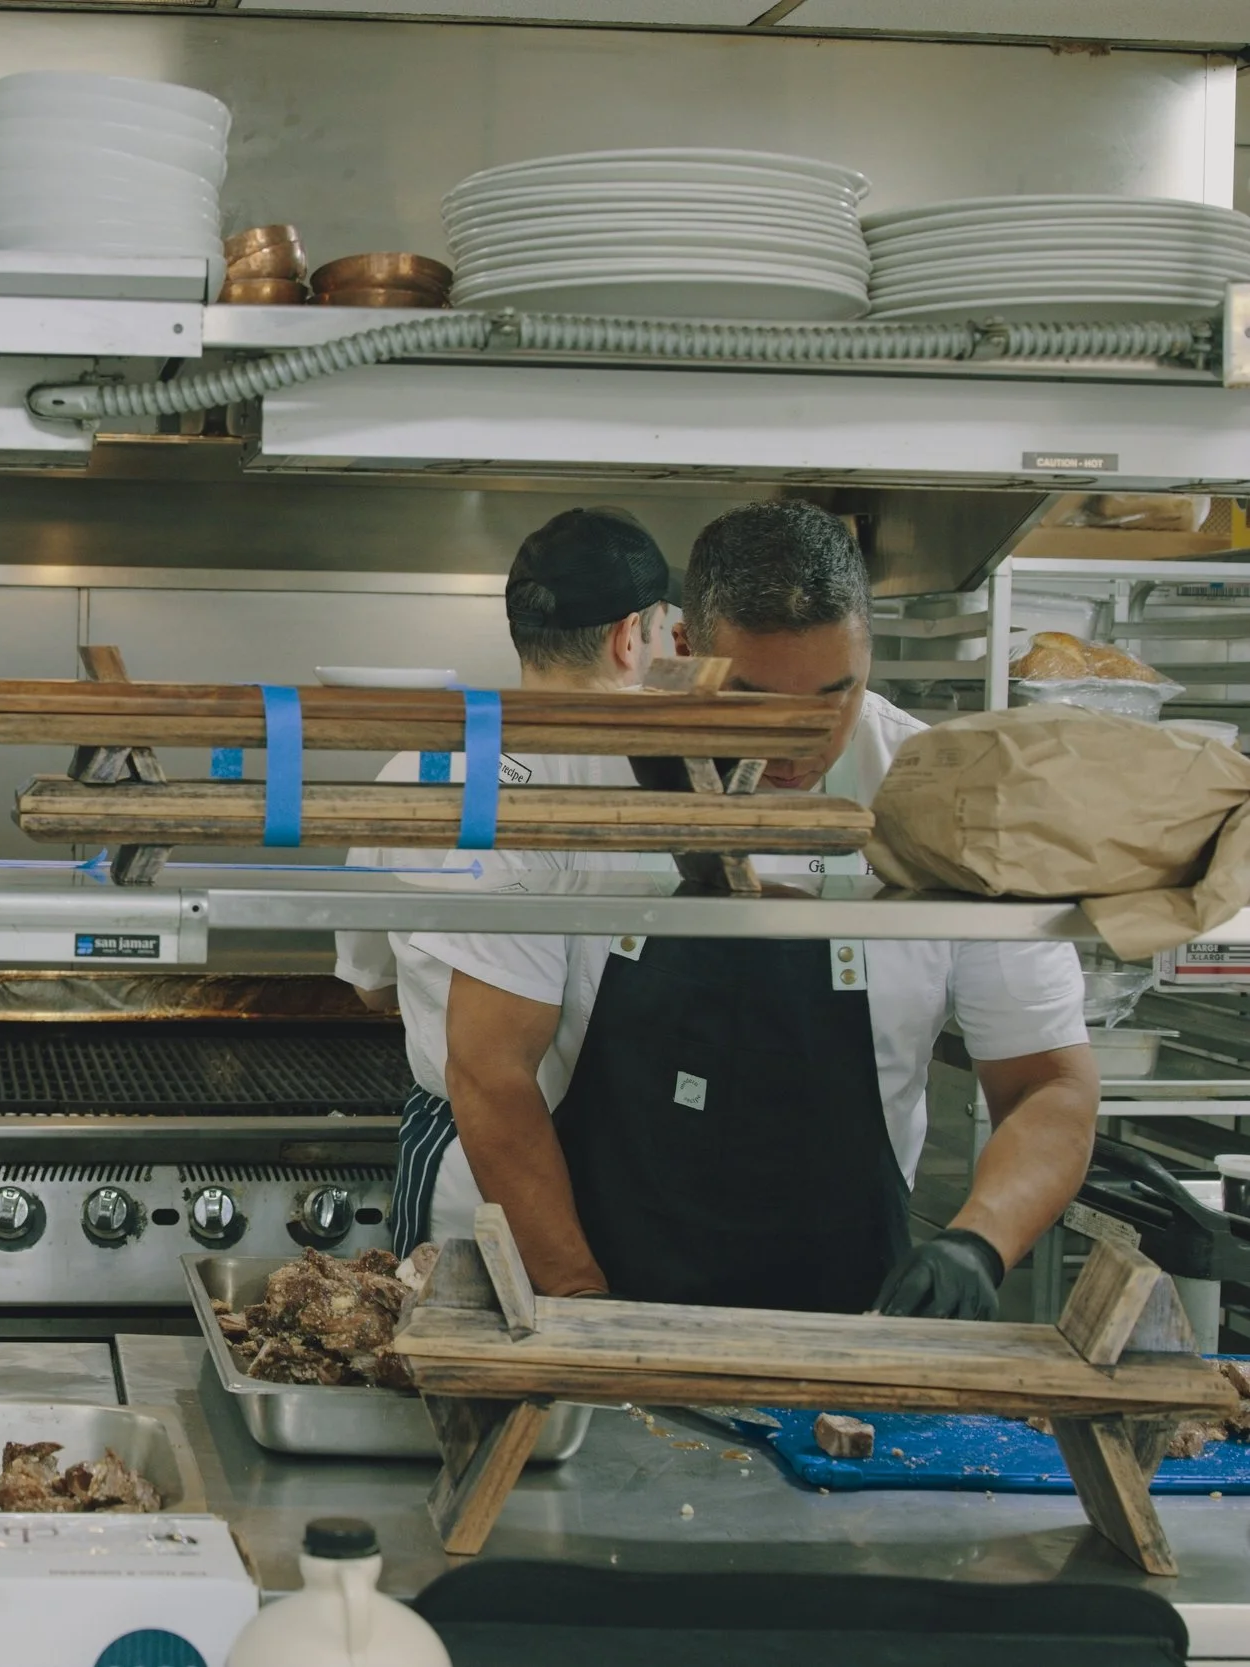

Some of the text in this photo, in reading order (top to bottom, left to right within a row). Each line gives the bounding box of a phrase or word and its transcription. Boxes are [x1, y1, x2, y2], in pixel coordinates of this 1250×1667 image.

[1036, 458, 1078, 468] CAUTION
[1084, 459, 1104, 468] HOT
[501, 764, 524, 783] recipe
[94, 937, 156, 951] san jamar
[1191, 944, 1219, 952] LARGE
